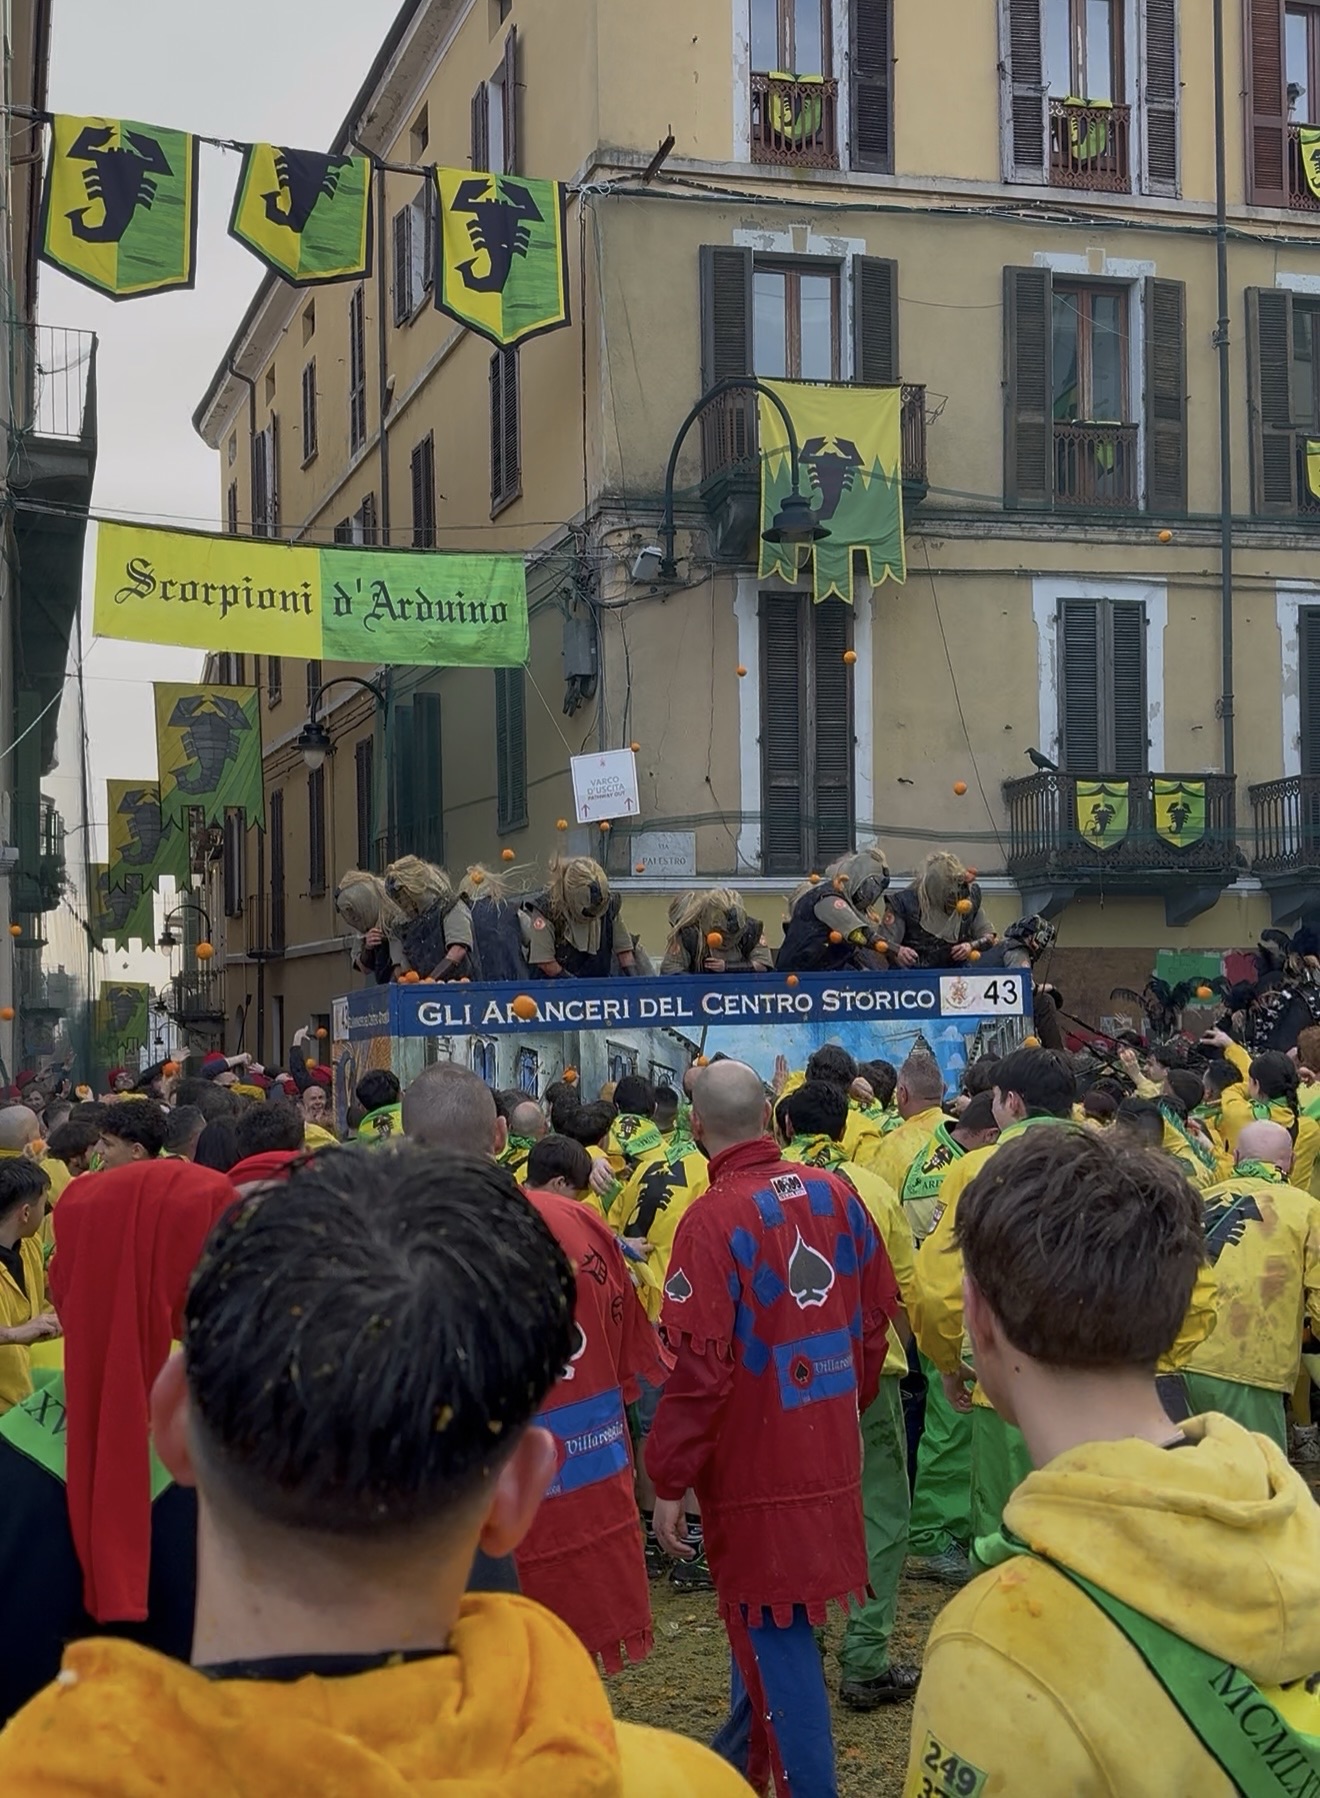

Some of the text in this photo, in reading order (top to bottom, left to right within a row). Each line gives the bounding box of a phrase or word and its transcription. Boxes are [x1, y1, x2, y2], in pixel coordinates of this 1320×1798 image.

[114, 557, 508, 632] Scorpioni d'Arduino
[587, 783, 626, 795] D'USCITA
[590, 776, 620, 786] VARCO
[642, 857, 686, 865] PALESTRO
[418, 1001, 471, 1026] GLI
[639, 996, 693, 1018] DEL
[701, 992, 813, 1016] CENTRO
[822, 988, 935, 1012] STORICO
[983, 979, 1018, 1005] 43
[1208, 1664, 1320, 1798] MCMLX
[924, 1740, 977, 1797] 249
